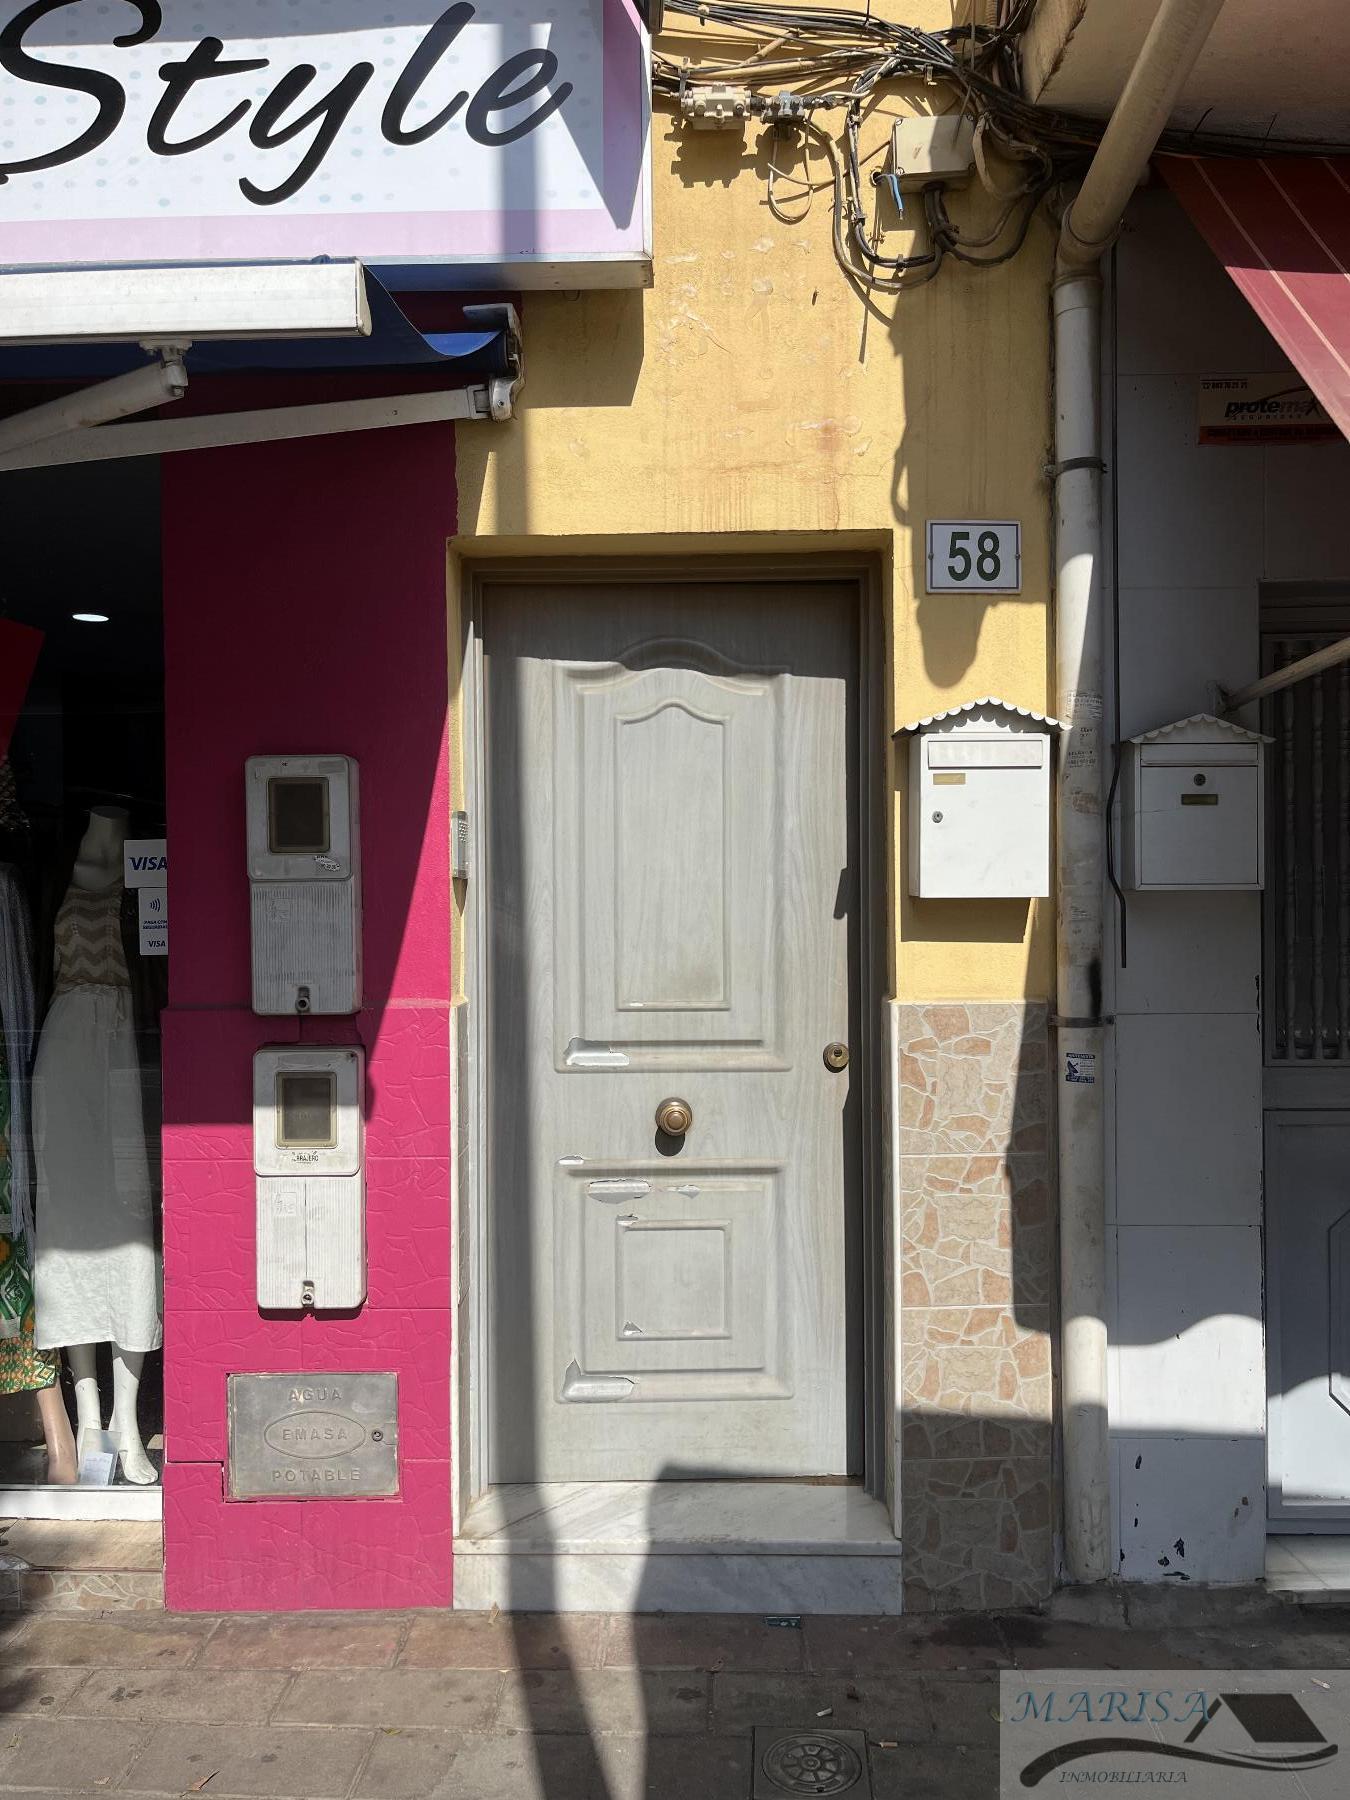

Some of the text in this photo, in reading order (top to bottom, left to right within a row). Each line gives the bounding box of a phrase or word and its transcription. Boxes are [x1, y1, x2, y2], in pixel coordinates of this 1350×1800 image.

[0, 0, 574, 206] Style
[947, 530, 1001, 582] 58
[128, 856, 168, 871] VISA
[146, 940, 166, 948] VISA
[288, 1387, 343, 1401] AGUA
[282, 1428, 349, 1441] EMASA
[272, 1468, 362, 1482] POTABLE
